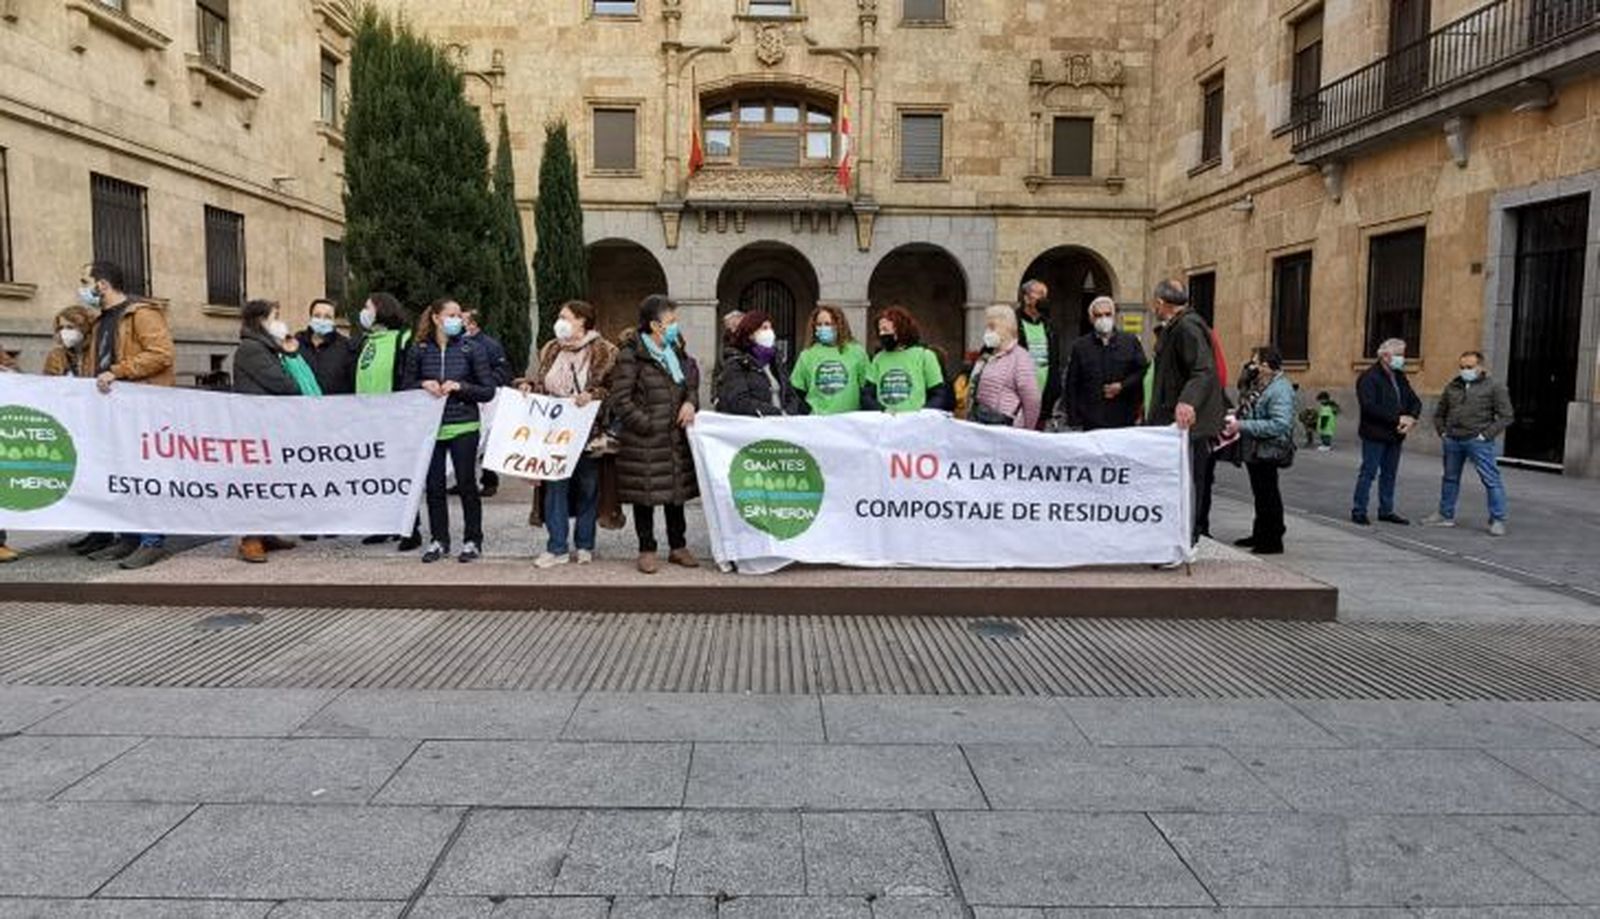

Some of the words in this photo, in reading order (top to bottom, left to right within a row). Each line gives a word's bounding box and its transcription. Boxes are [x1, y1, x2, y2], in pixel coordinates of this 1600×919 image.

[529, 398, 563, 419] NO
[142, 426, 272, 464] ¡ÚNETE!
[282, 442, 386, 463] PORQUE
[513, 426, 530, 440] A
[543, 430, 571, 444] LA
[743, 459, 806, 471] GAJATES
[890, 453, 939, 480] NO
[946, 462, 961, 480] A
[969, 463, 995, 480] LA
[1003, 463, 1093, 483] PLANTA
[1100, 467, 1130, 484] DE
[108, 475, 162, 496] ESTO
[169, 480, 218, 498] NOS
[225, 482, 317, 499] AFECTA
[323, 482, 340, 497] A
[855, 500, 1003, 520] COMPOSTAJE
[1012, 503, 1040, 520] DE
[1048, 504, 1163, 523] RESIDUOS
